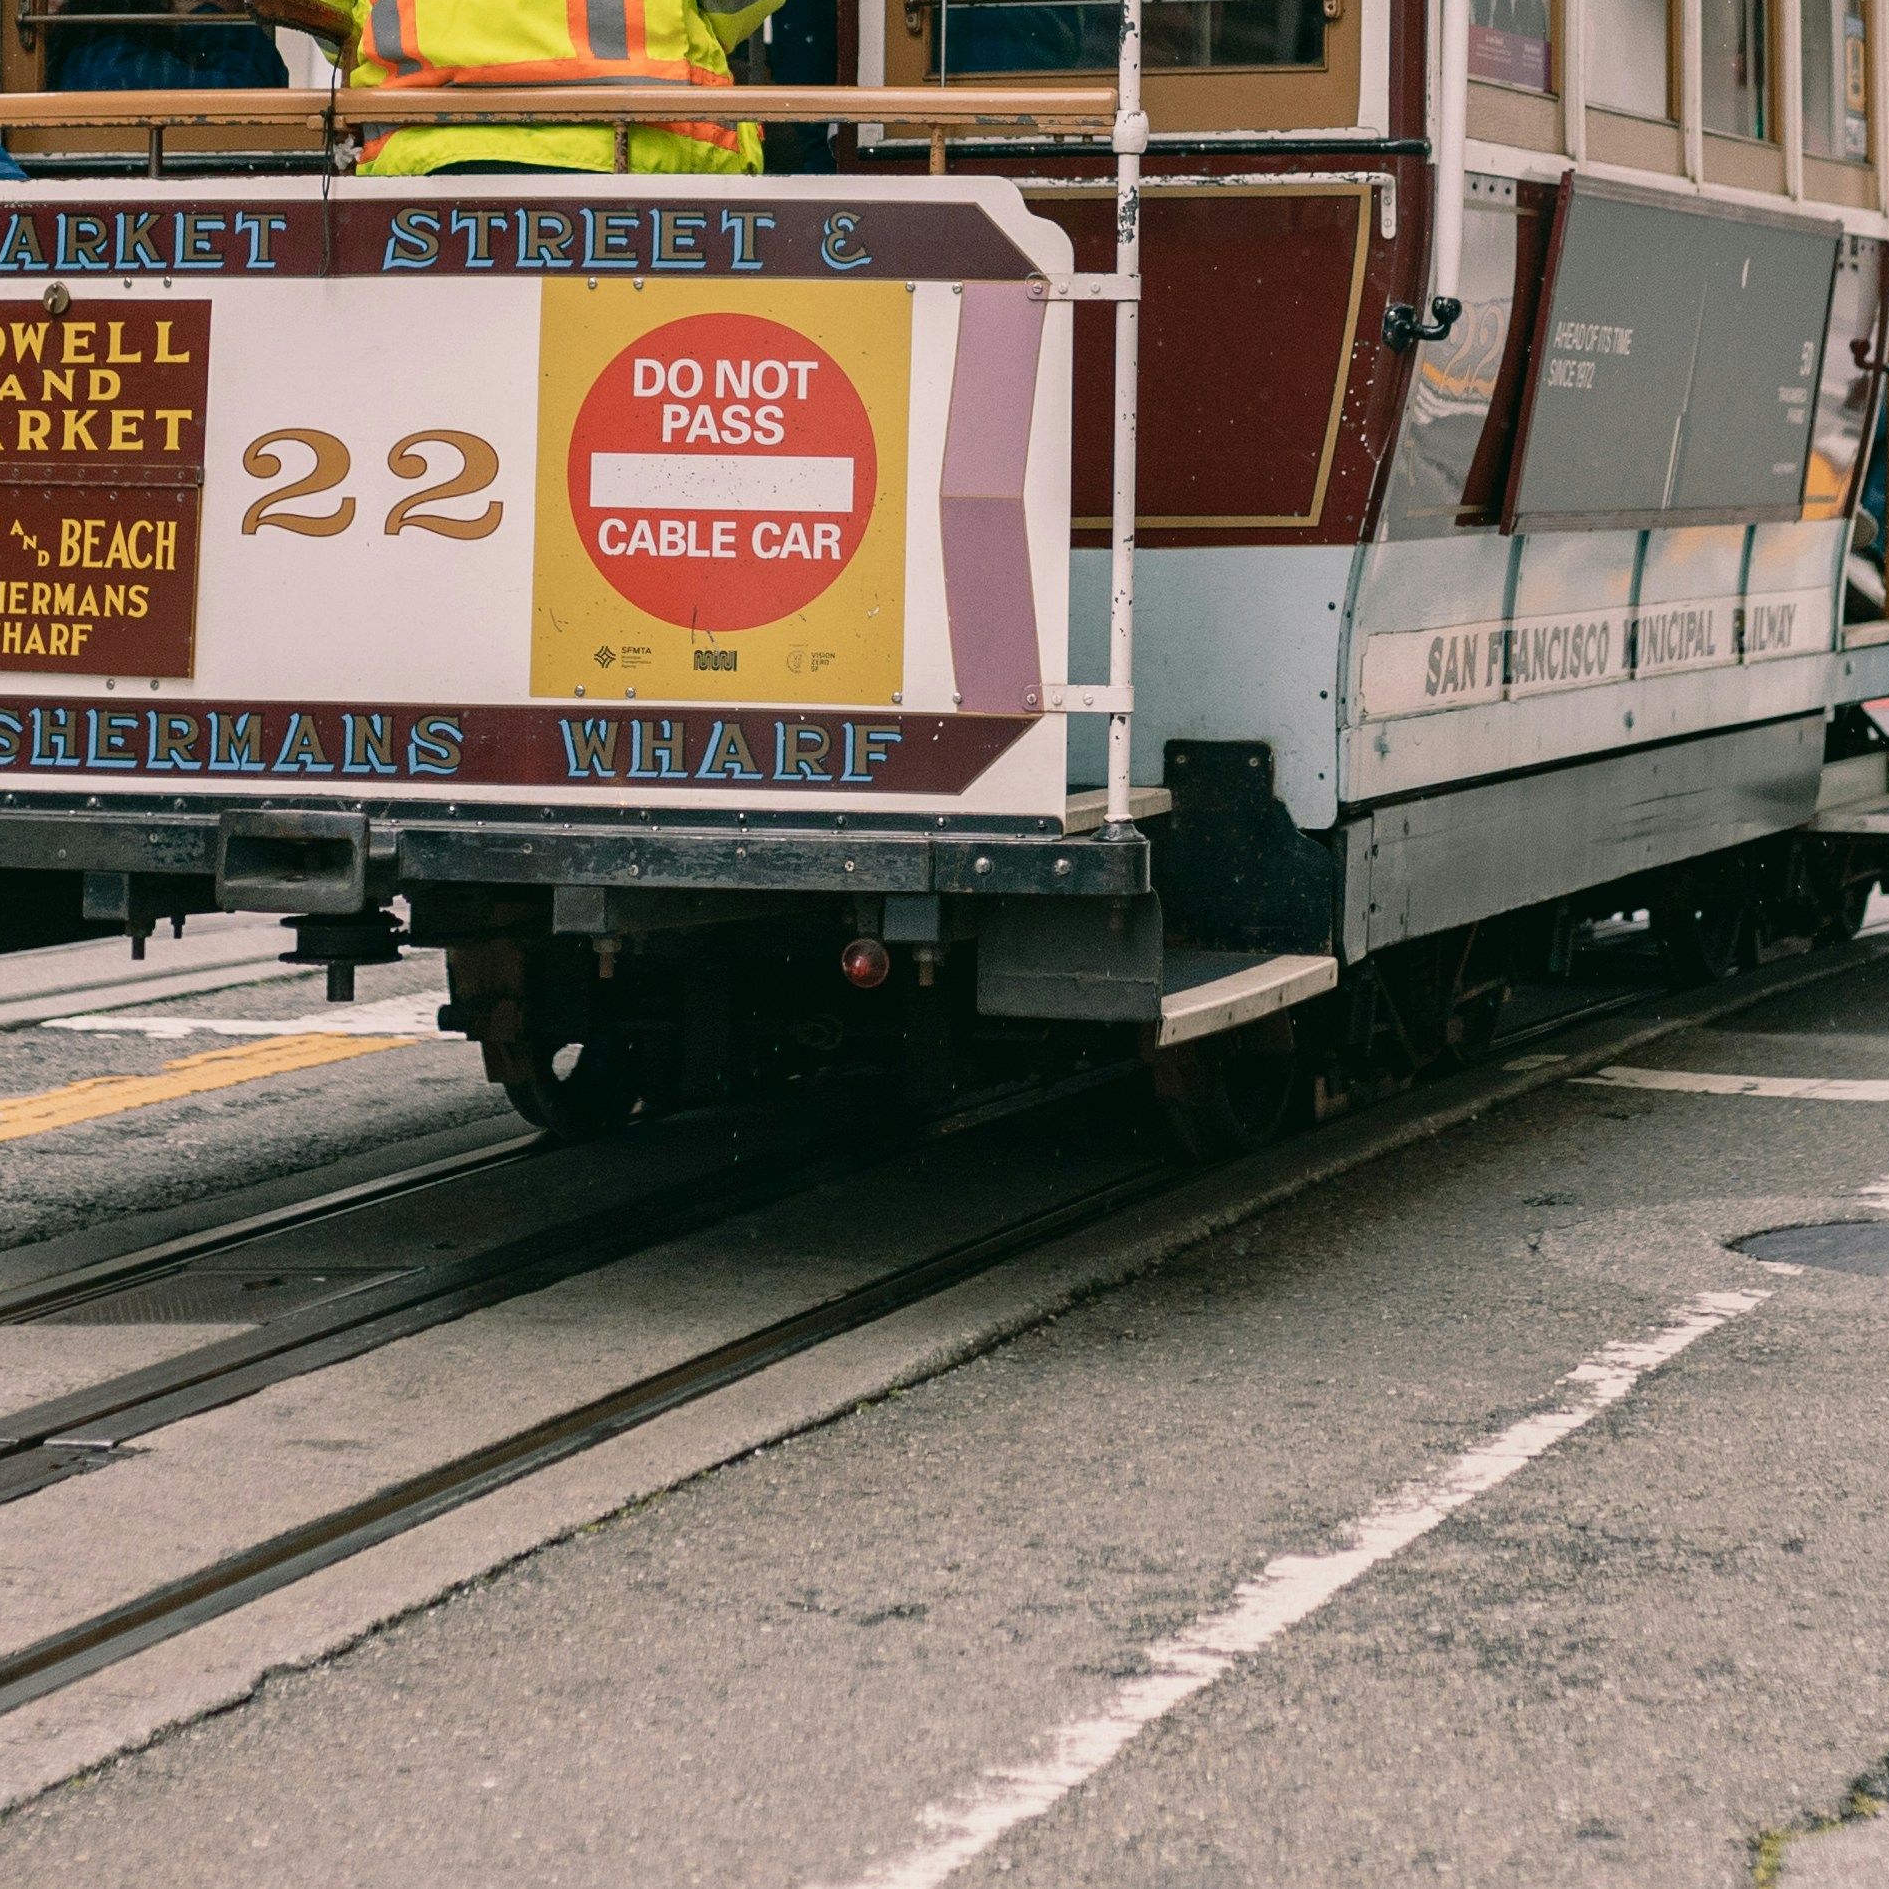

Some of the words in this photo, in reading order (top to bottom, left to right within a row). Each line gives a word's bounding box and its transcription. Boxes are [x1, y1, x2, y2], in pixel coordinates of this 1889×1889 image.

[382, 206, 777, 273] STREET
[820, 207, 875, 271] &
[1553, 320, 1584, 351] AHEAD
[1614, 326, 1634, 355] TIME
[633, 359, 711, 401] DO
[716, 359, 819, 401] NOT
[1548, 358, 1576, 388] SINCE
[660, 403, 786, 449] PASS
[241, 428, 505, 543] 22
[7, 519, 51, 569] AND
[58, 517, 178, 572] BEACH
[597, 516, 743, 560] CABLE
[751, 519, 843, 563] CAR
[621, 646, 652, 655] SFMTA
[1426, 635, 1479, 698] SAN
[1729, 603, 1797, 655] RILWAY
[564, 716, 906, 783] WHARF
